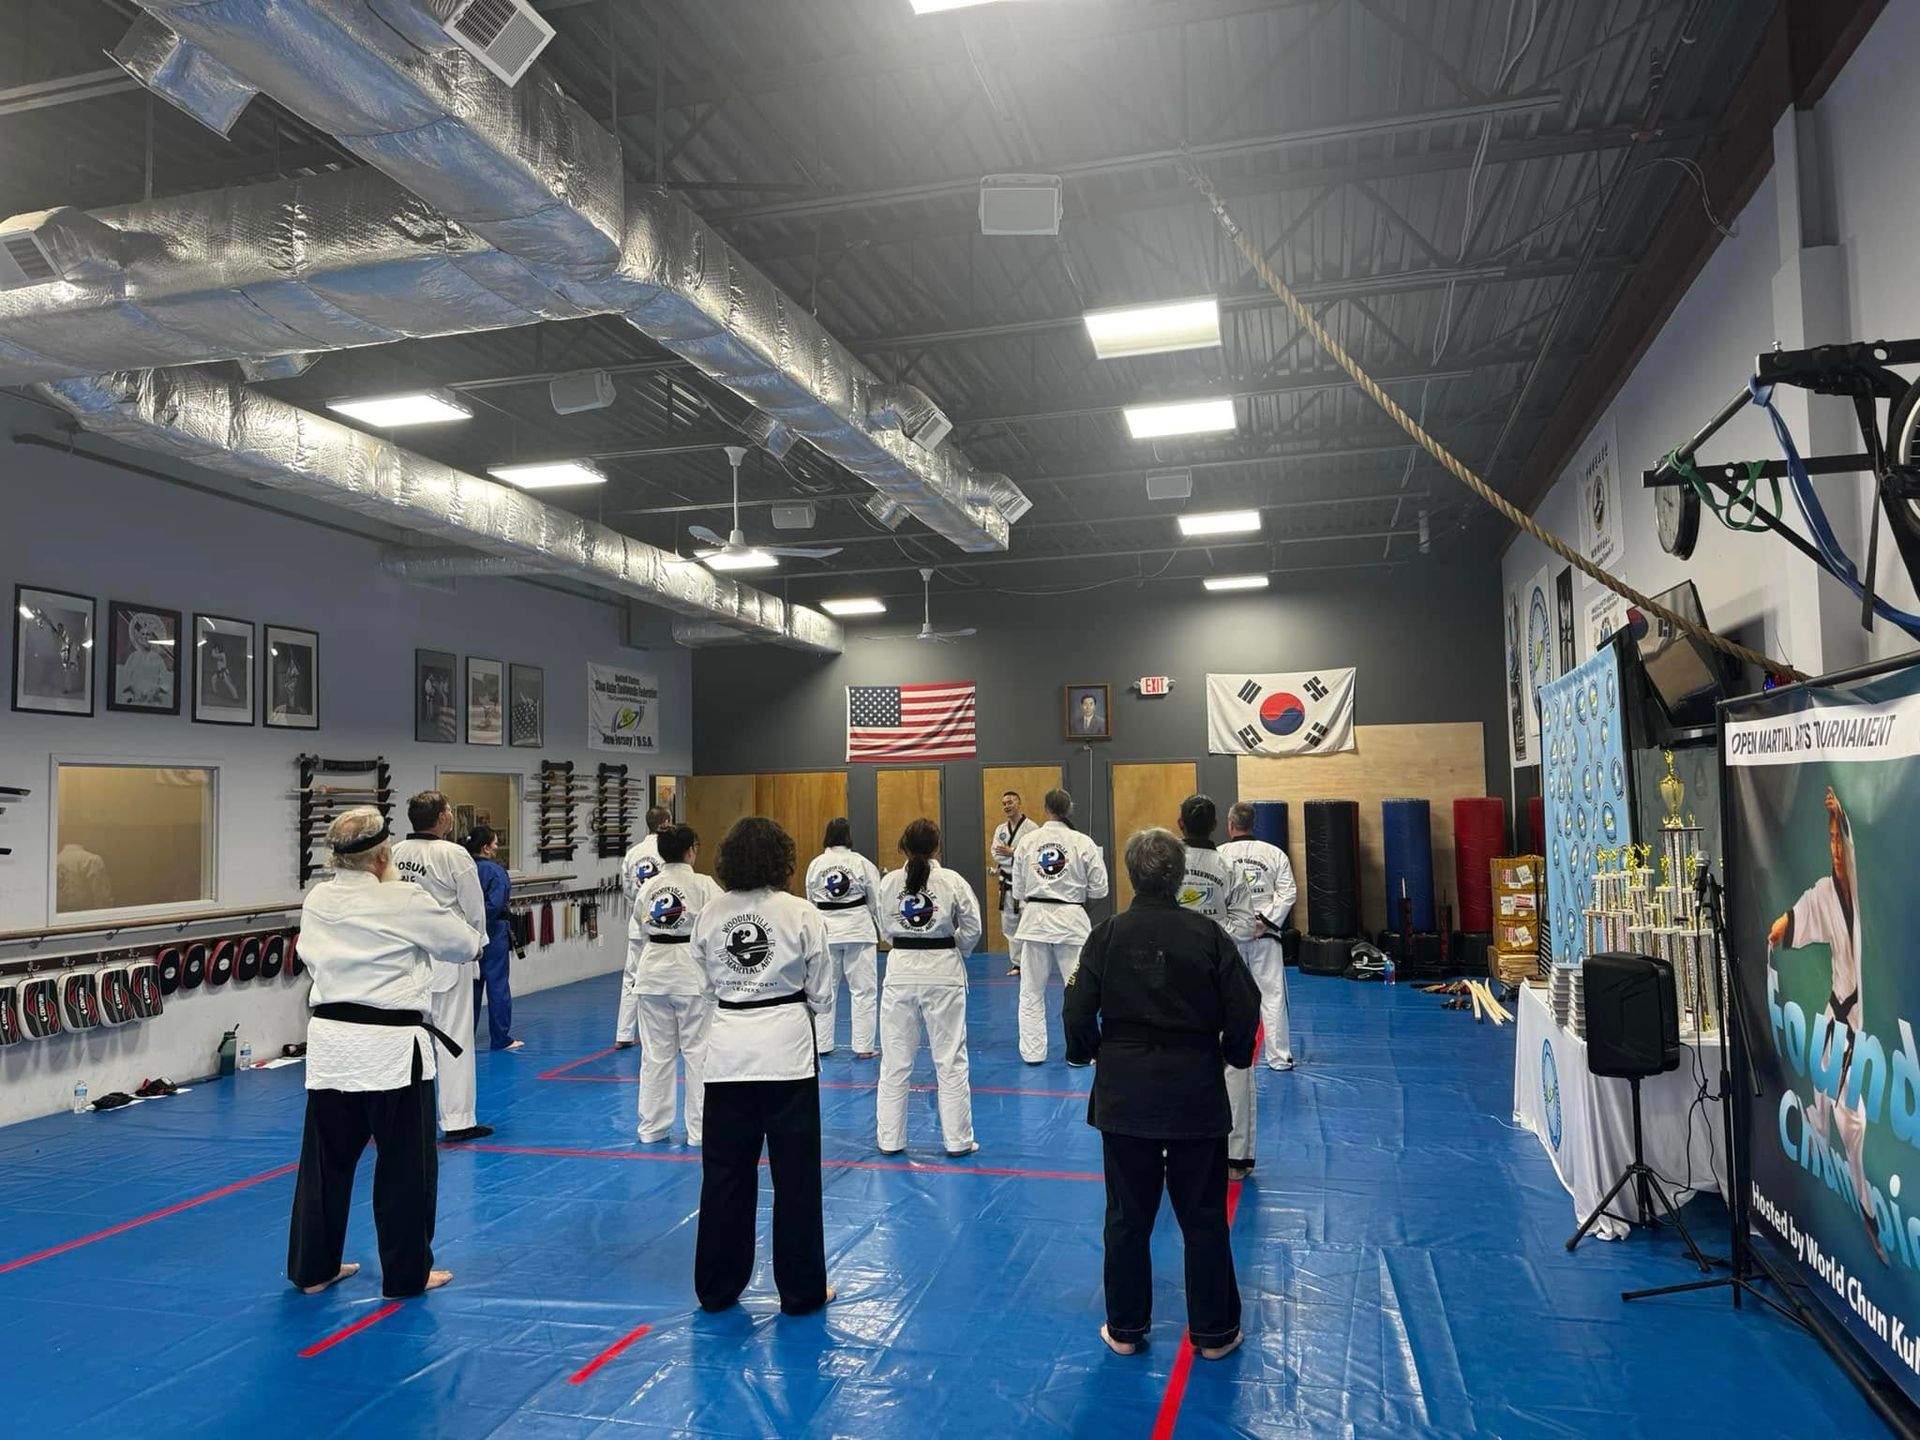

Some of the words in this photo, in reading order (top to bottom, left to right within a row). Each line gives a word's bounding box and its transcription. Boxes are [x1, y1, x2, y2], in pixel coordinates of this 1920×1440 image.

[1145, 678, 1165, 693] EXIT
[1732, 731, 1757, 755] OPEN
[1758, 726, 1793, 753] MARTIAL
[395, 861, 427, 877] OSUN
[721, 914, 773, 935] WOODINVILLE
[725, 959, 761, 974] MARTIAL
[761, 951, 774, 970] ARTS
[1752, 1180, 1788, 1240] Hosted
[1790, 1216, 1804, 1262] by
[1806, 1232, 1845, 1299] World
[1847, 1276, 1888, 1343] Chun
